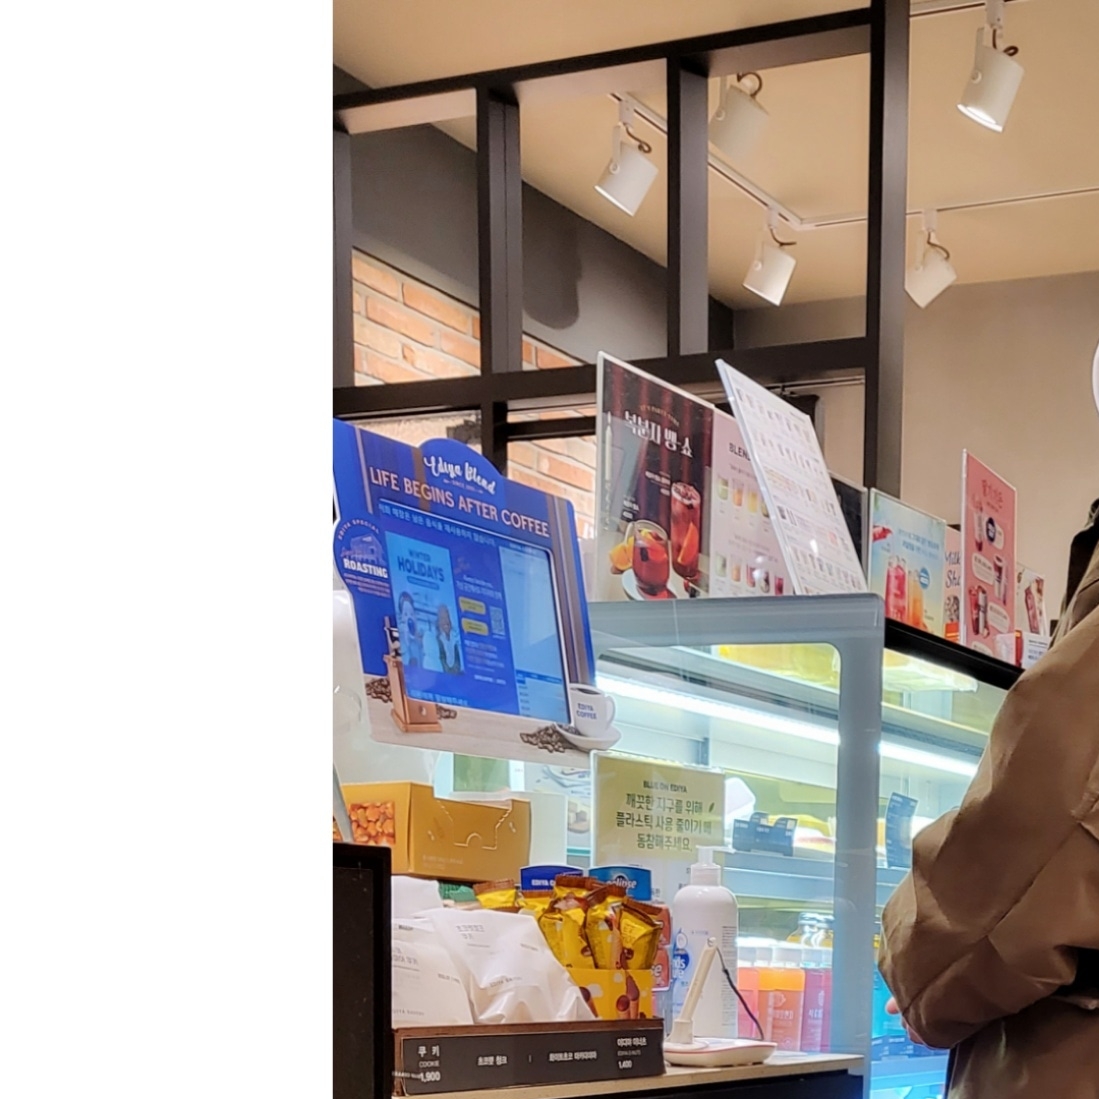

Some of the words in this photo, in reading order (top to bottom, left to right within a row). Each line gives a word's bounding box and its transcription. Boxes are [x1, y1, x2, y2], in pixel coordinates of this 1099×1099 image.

[369, 466, 400, 491] LIFE
[403, 477, 455, 508] BEGINS
[458, 495, 499, 522] AFTER
[501, 509, 550, 538] COFFEE
[342, 558, 389, 578] ROASTING
[397, 556, 446, 582] HOLIDAYS
[625, 792, 654, 811] 깨끗한
[656, 796, 684, 814] 지구를
[685, 800, 703, 815] 위해
[616, 811, 653, 830] 플라스틱
[655, 815, 674, 832] 사용
[418, 1060, 440, 1068] COOKIE
[420, 1071, 441, 1082] 1,900
